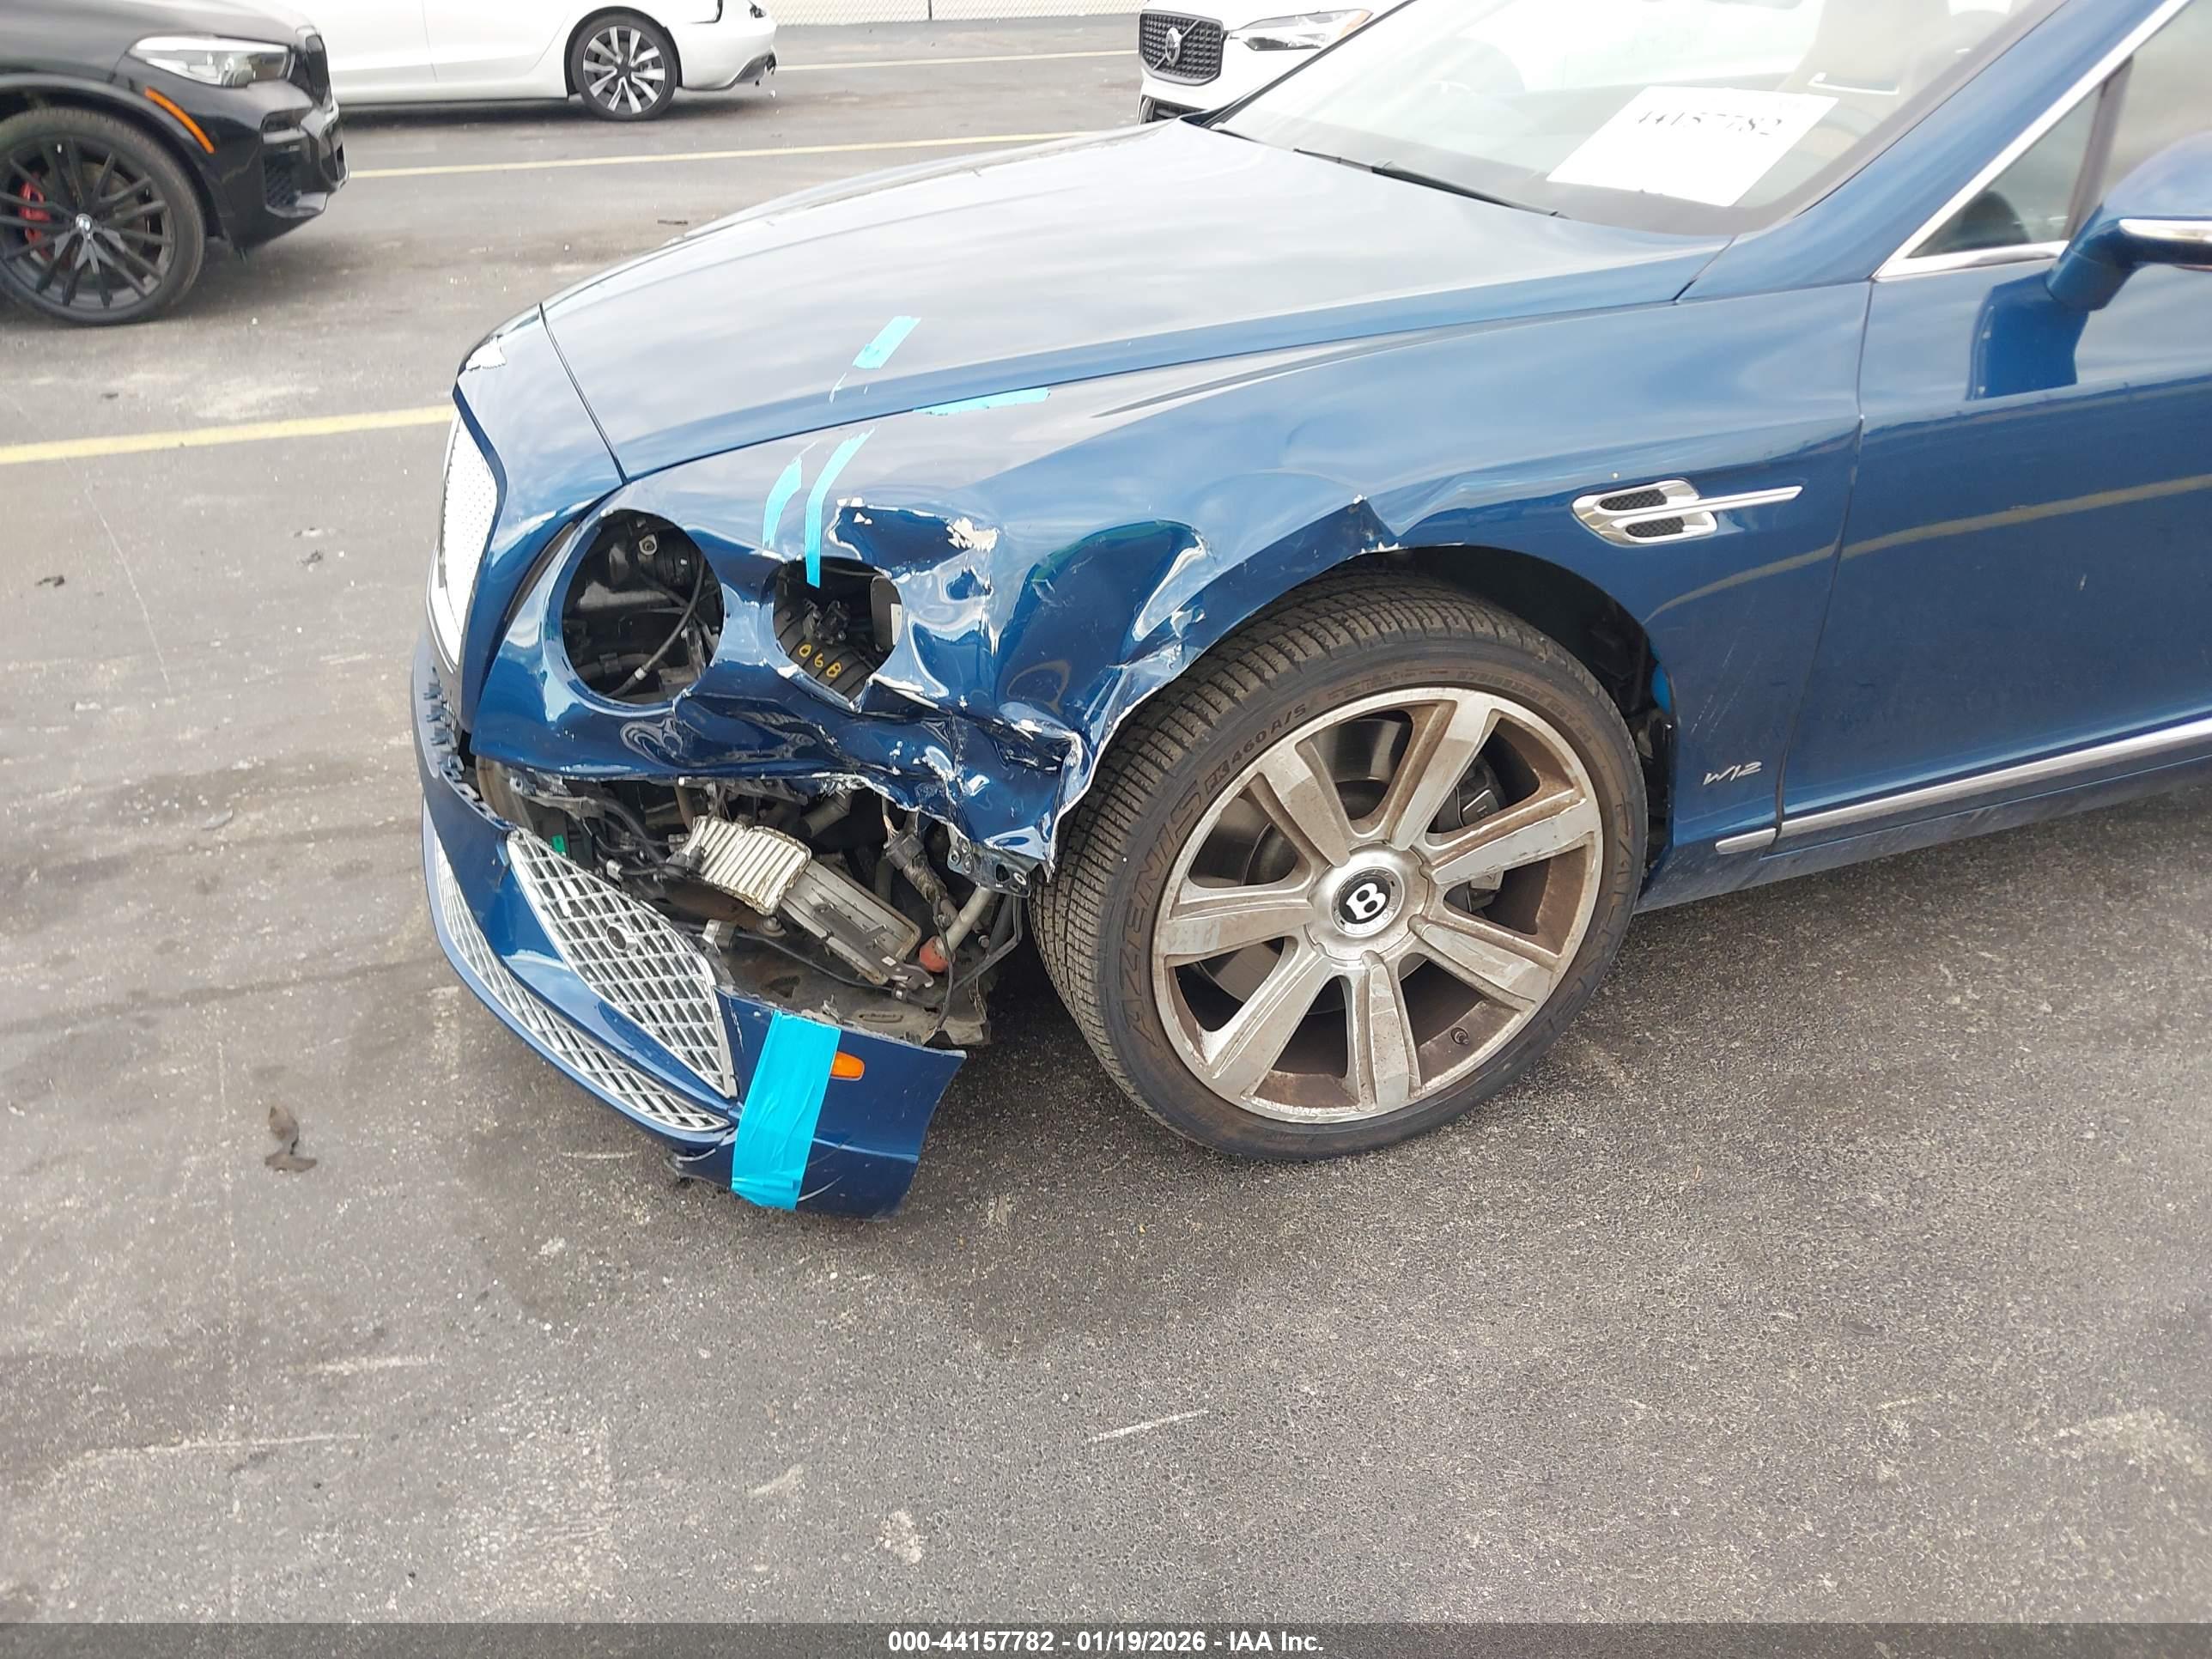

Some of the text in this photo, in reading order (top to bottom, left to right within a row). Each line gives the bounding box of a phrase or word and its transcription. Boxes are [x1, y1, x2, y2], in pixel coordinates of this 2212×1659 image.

[1703, 761, 1762, 786] W12
[1118, 779, 1202, 1048] AZENIS
[1270, 703, 1307, 734] A/S
[1346, 882, 1387, 921] B
